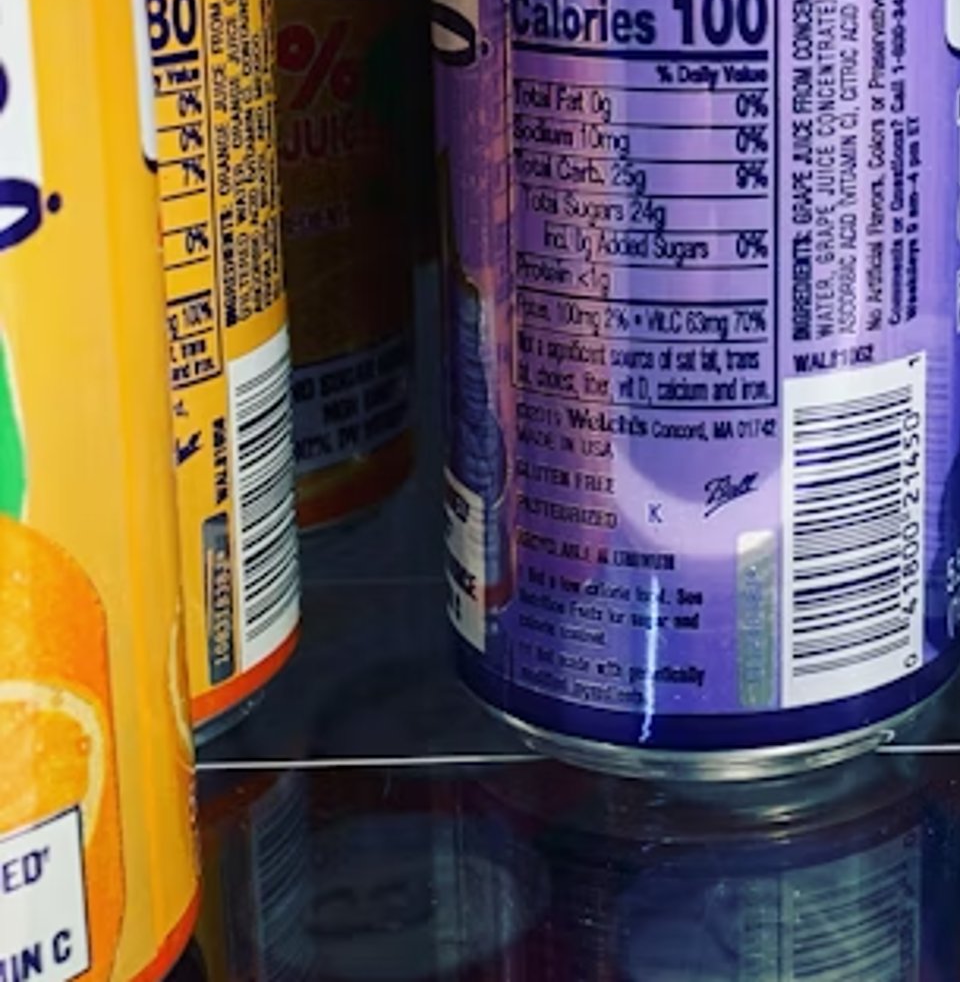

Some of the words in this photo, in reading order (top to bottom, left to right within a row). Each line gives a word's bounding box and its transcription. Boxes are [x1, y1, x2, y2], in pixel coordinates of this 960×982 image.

[555, 85, 583, 113] Fat
[735, 93, 769, 118] 0%
[791, 67, 813, 114] FROM
[735, 127, 769, 155] 0%
[791, 119, 813, 165] JUICE
[816, 145, 836, 197] JUICE
[791, 170, 813, 224] GRAPE
[654, 235, 710, 267] Sugars
[735, 233, 769, 259] 0%
[815, 205, 836, 265] GRAPE
[902, 410, 920, 508] 21450
[902, 521, 920, 615] 41800
[53, 928, 71, 964] C
